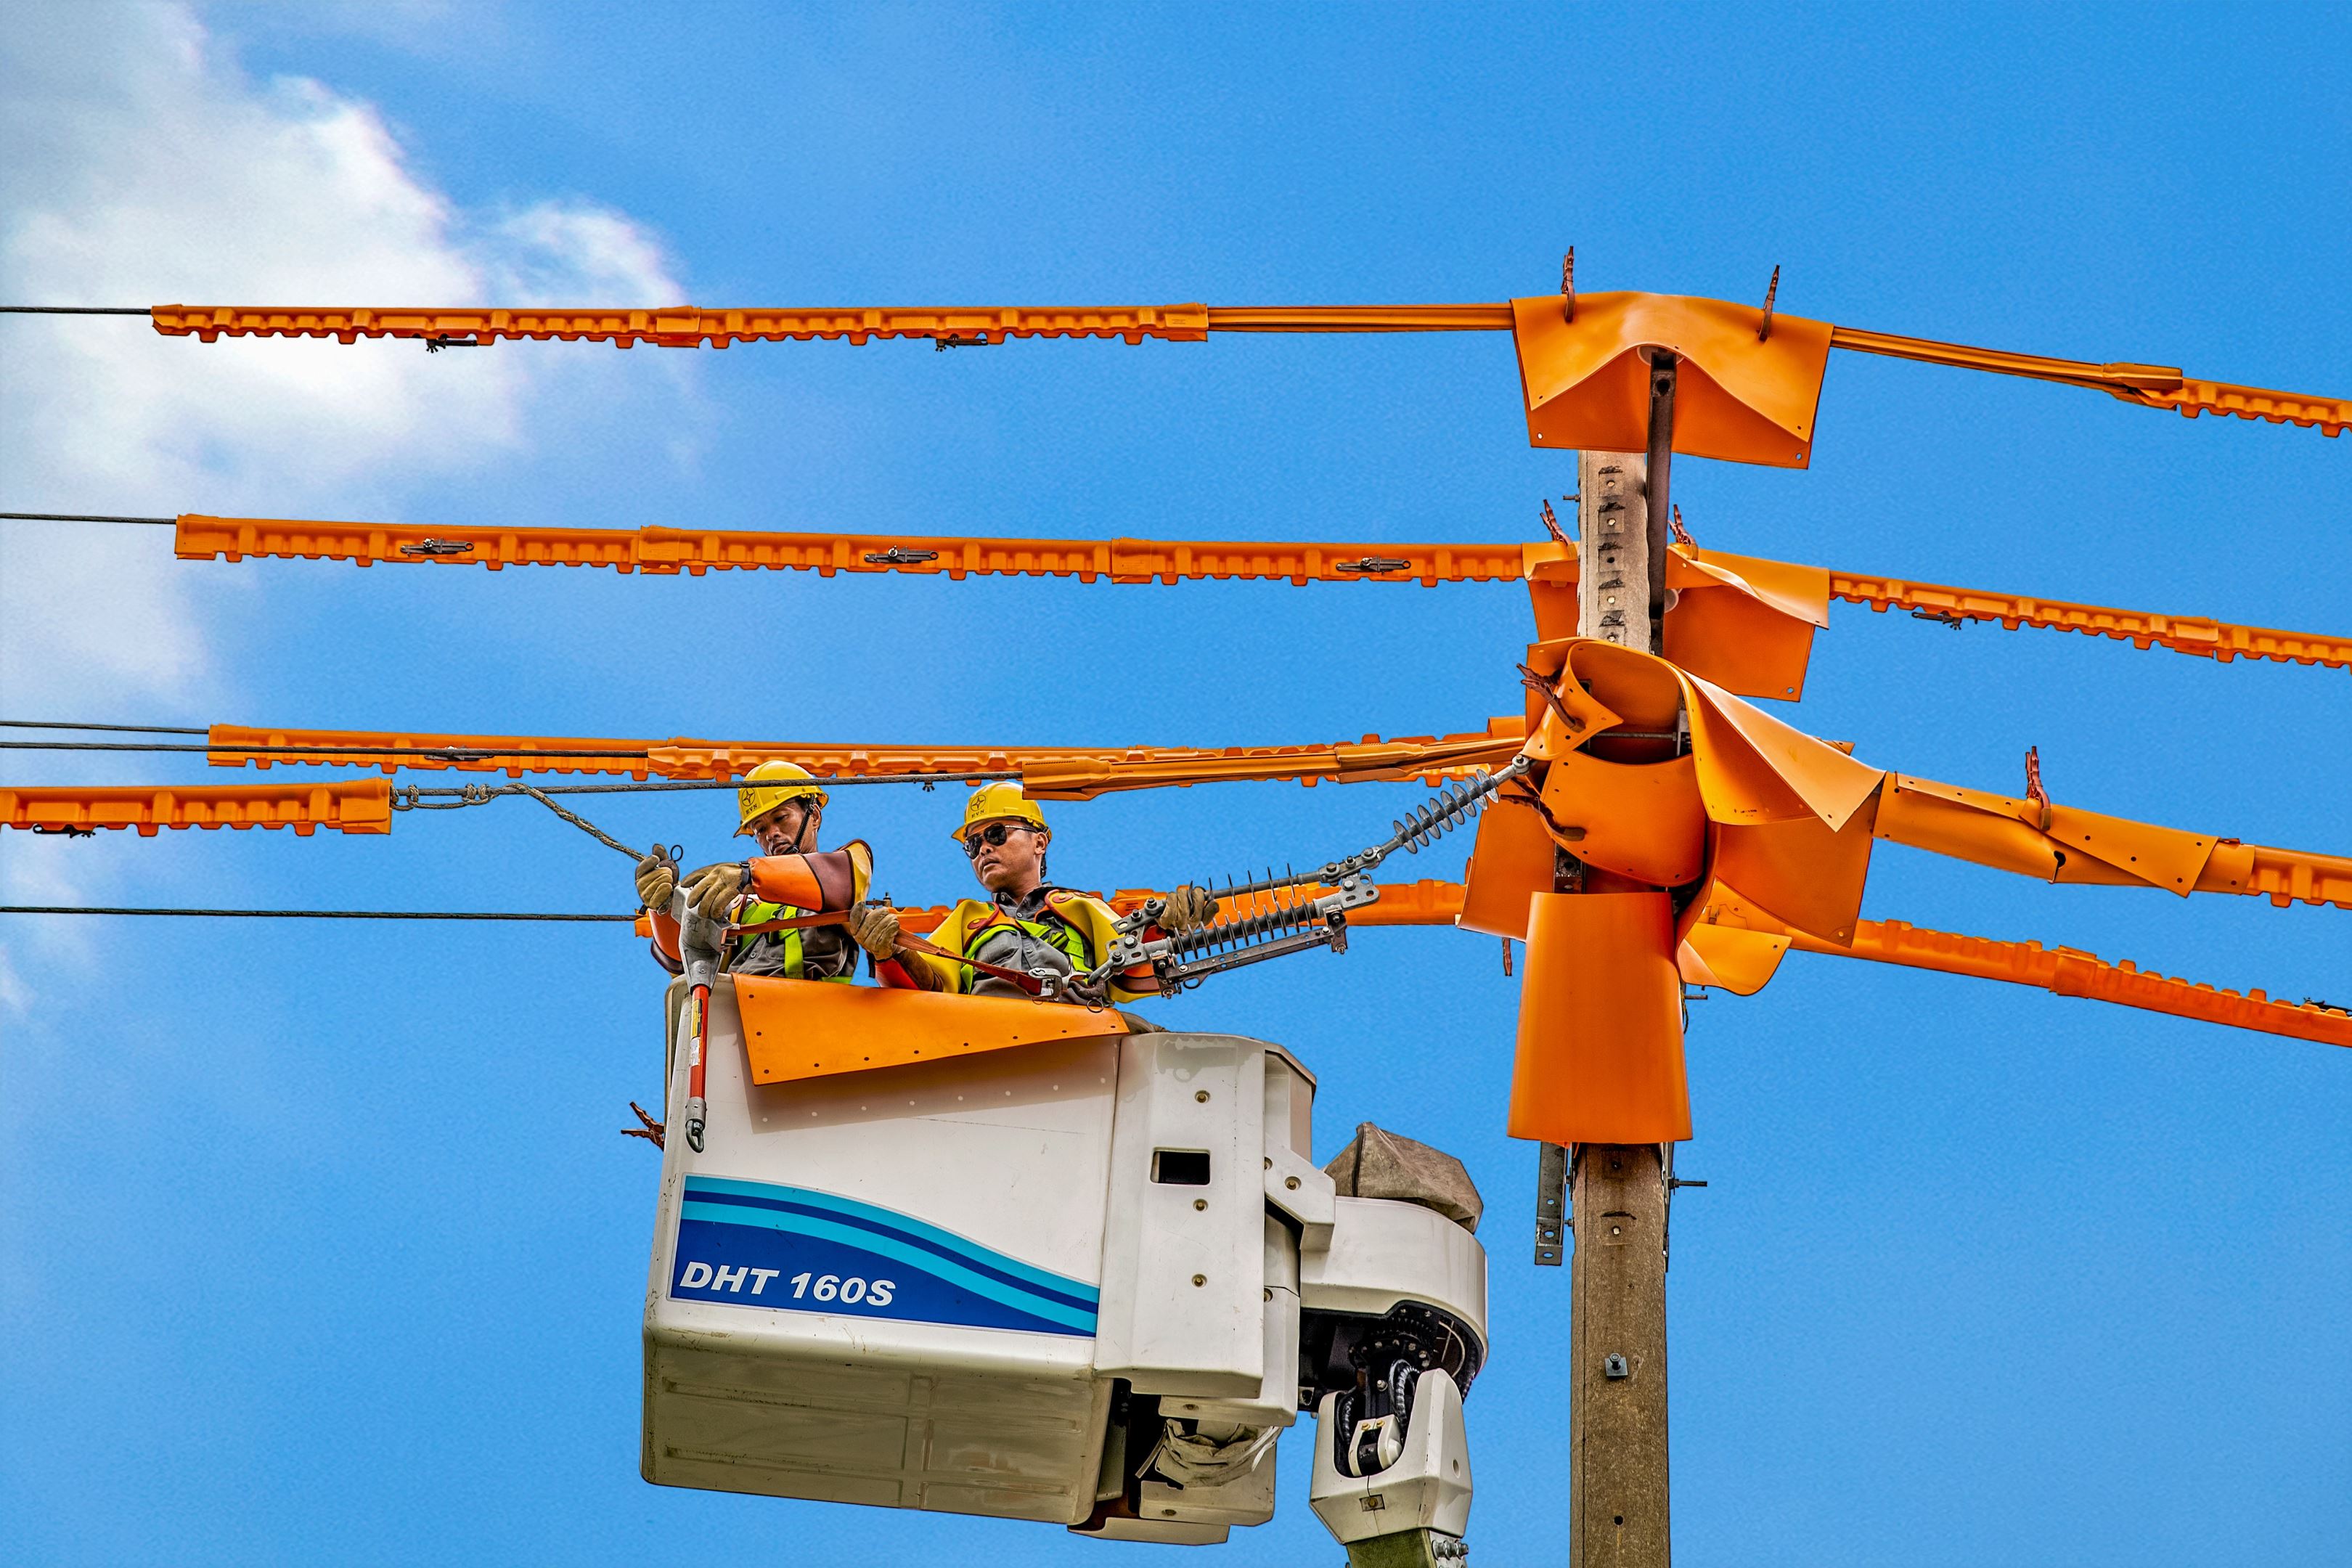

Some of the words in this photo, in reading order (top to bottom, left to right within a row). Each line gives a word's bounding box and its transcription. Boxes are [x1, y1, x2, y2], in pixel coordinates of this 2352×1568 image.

[746, 803, 758, 814] EVN
[971, 809, 984, 818] EVN
[679, 1262, 780, 1294] DHT
[791, 1273, 896, 1306] 160S
